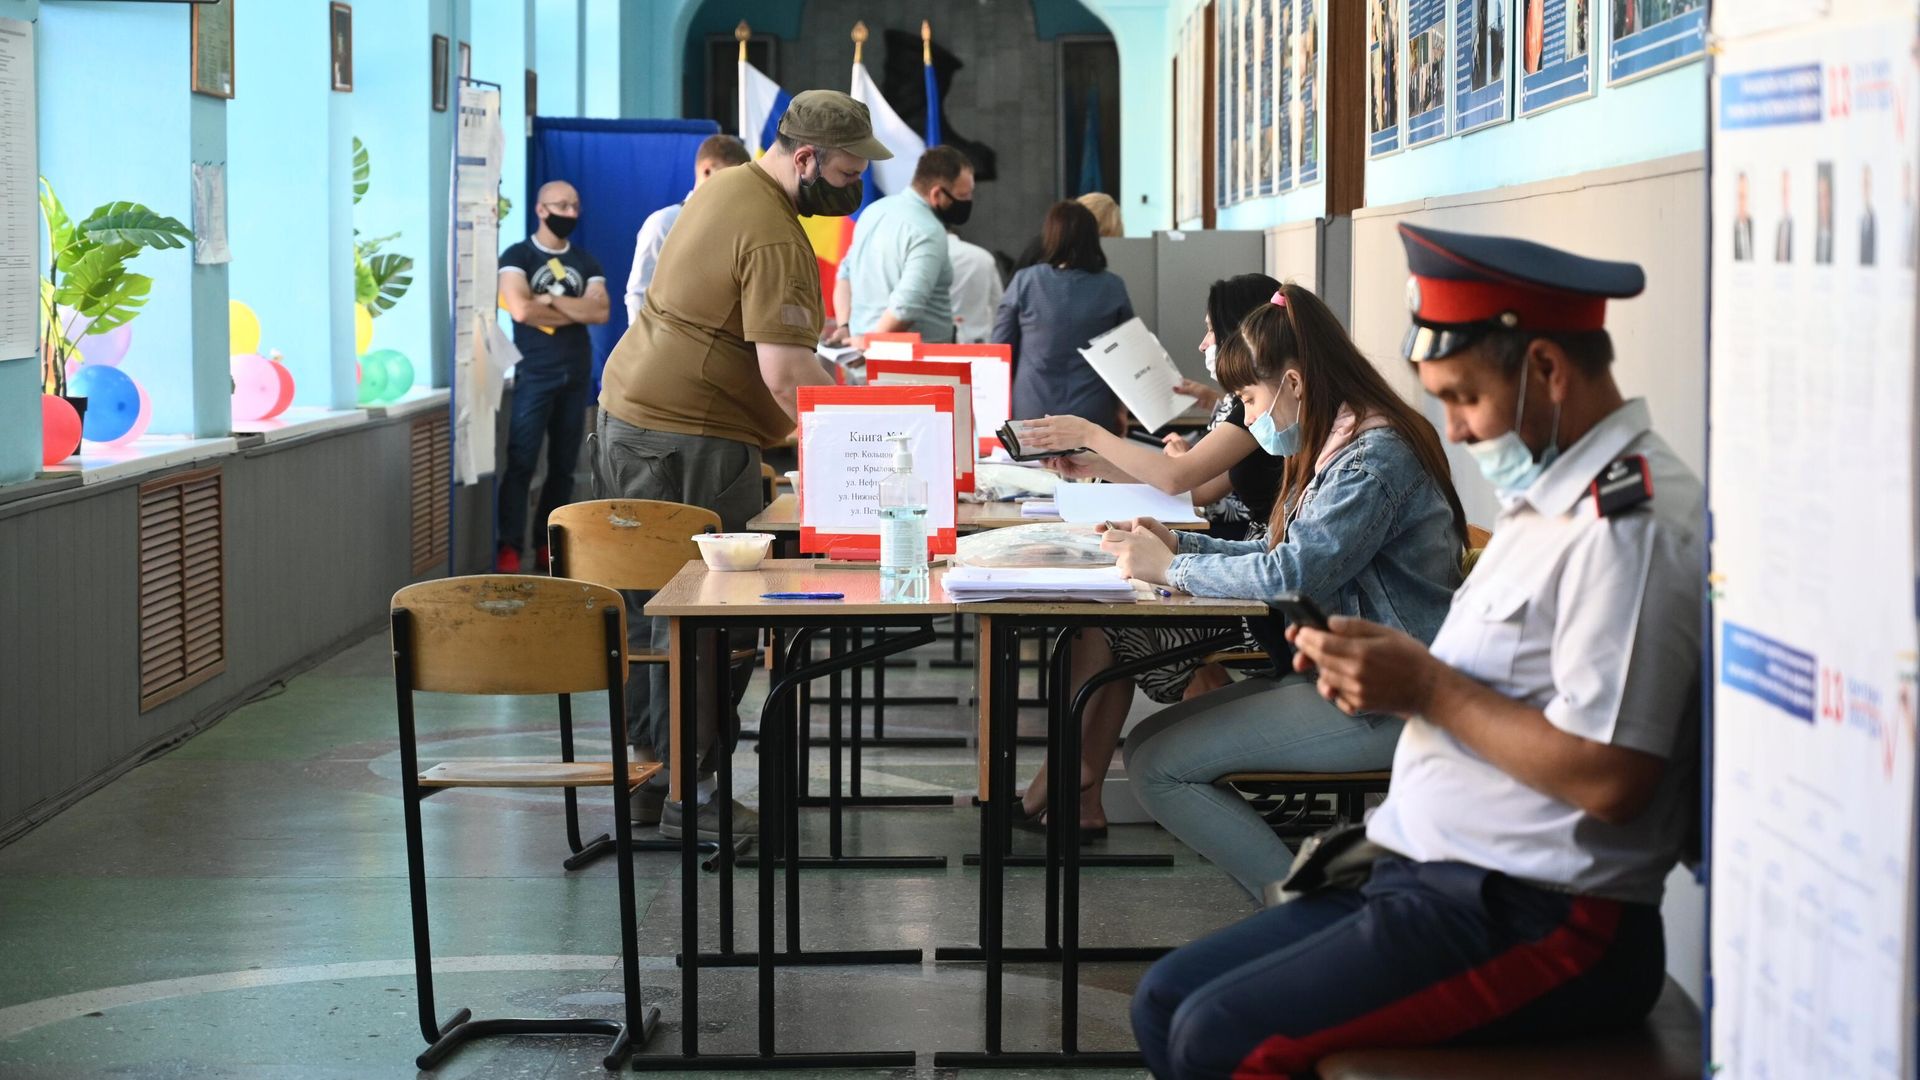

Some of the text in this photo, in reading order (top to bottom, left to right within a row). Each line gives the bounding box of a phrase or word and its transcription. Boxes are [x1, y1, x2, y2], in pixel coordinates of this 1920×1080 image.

[850, 431, 883, 442] Книга
[845, 451, 860, 460] пер.
[847, 465, 861, 474] пер.
[846, 480, 857, 488] ул.
[838, 494, 850, 502] ул.
[851, 508, 861, 516] ул.
